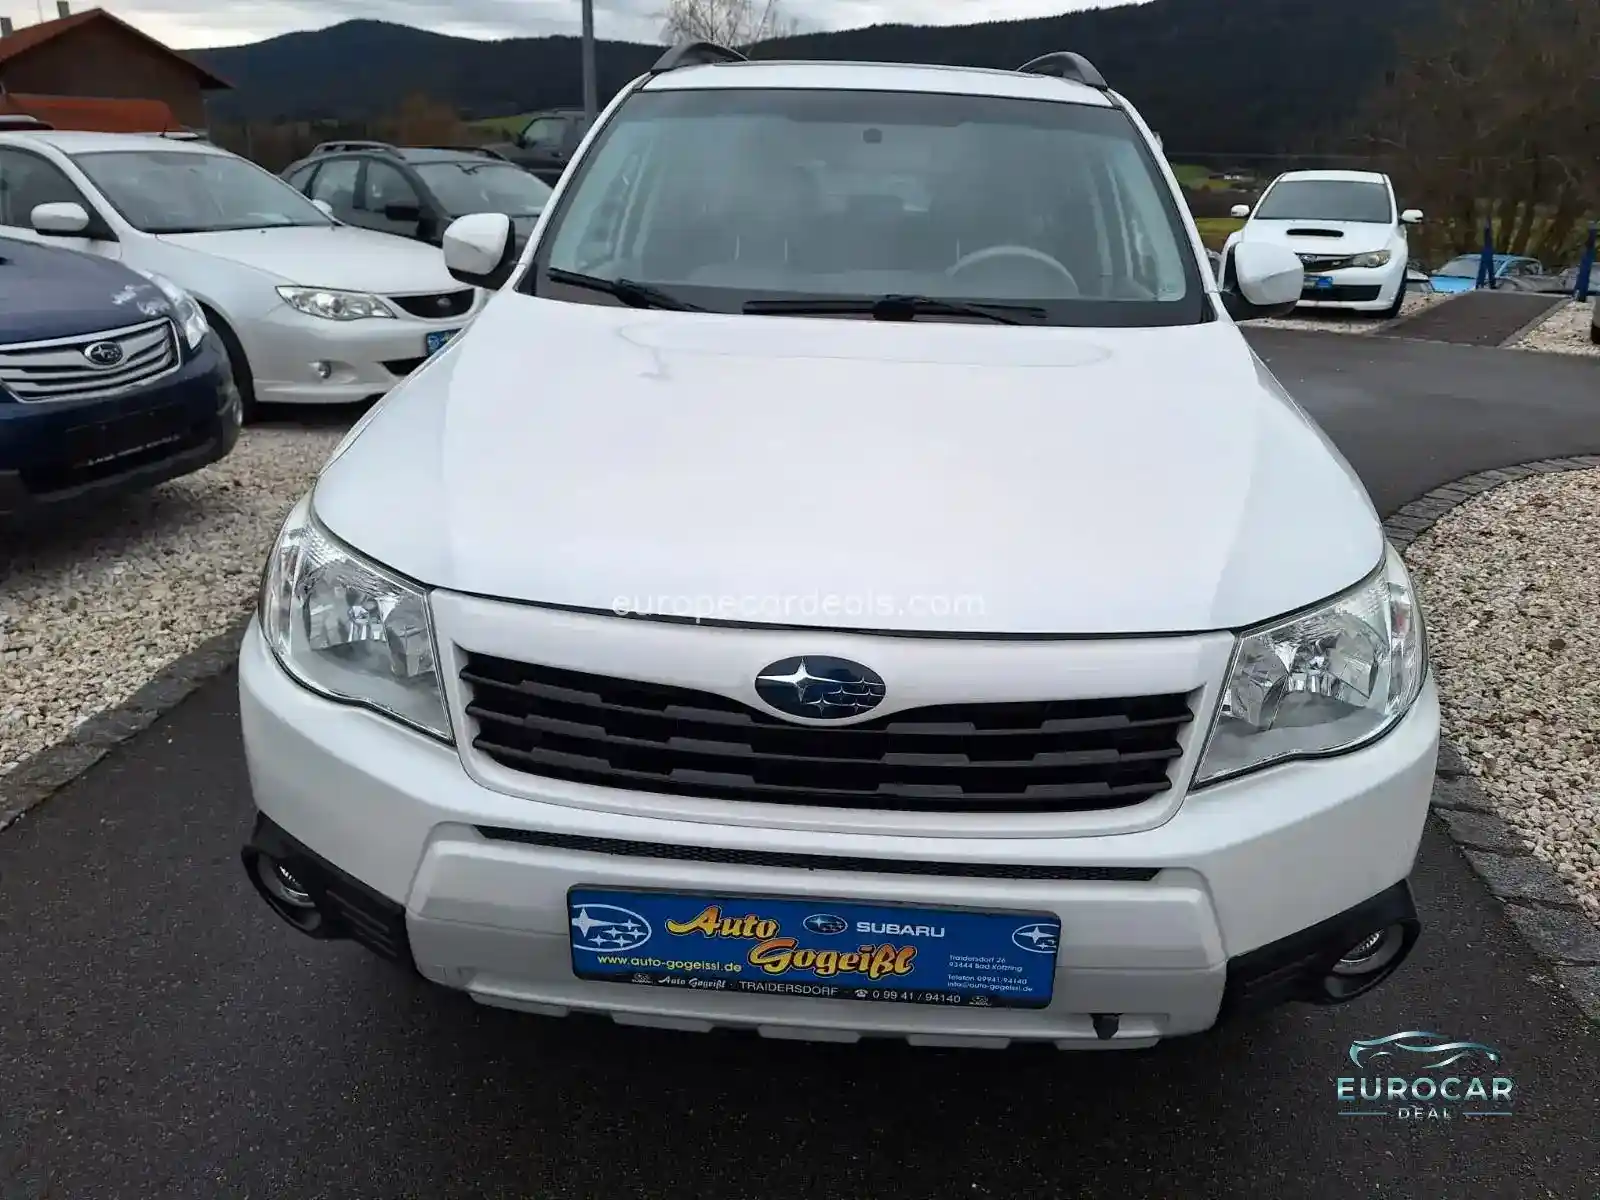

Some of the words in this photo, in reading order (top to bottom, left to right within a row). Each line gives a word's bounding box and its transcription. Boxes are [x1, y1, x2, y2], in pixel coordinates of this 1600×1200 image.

[665, 905, 780, 940] Auto
[856, 921, 945, 938] SUBARU
[597, 954, 742, 973] www.auto-gogeissl.de
[748, 938, 917, 981] Gogeißl
[948, 961, 973, 969] 93444
[949, 954, 995, 963] Traidersdorf
[658, 975, 686, 985] Auto
[739, 981, 839, 996] TRAIDERSDORF
[947, 974, 975, 982] Telefon
